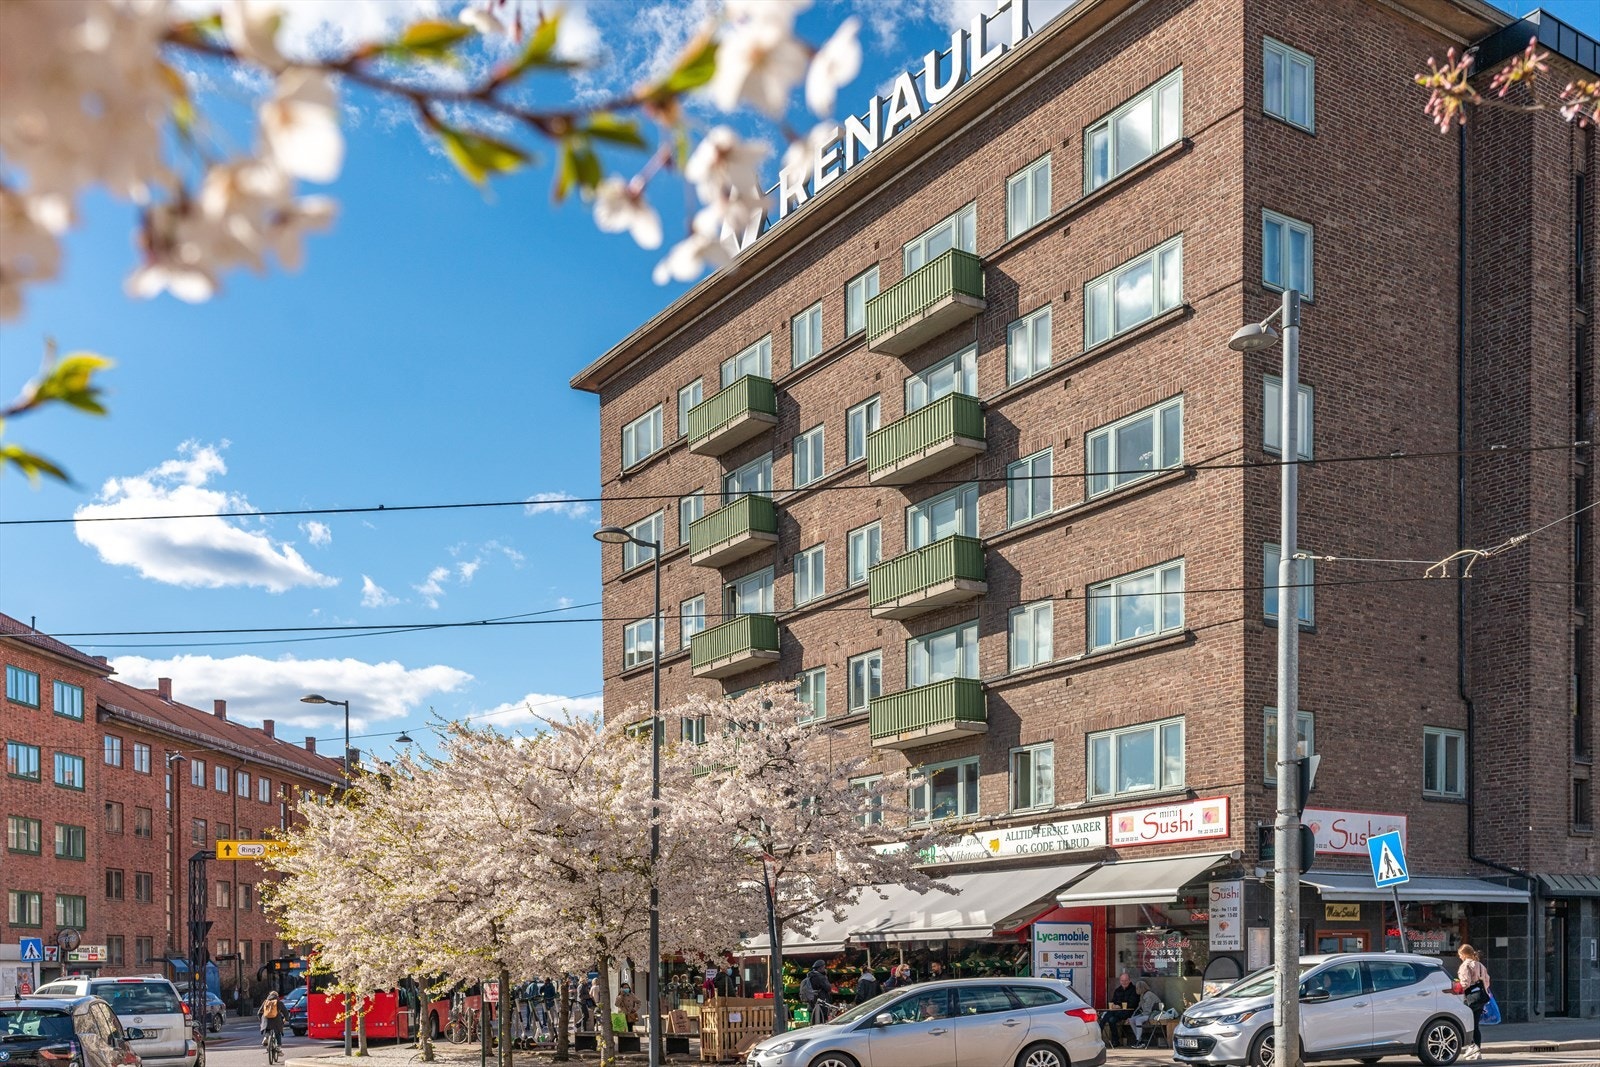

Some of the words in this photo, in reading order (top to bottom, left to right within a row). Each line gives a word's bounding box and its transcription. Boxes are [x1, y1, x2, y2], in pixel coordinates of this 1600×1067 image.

[779, 0, 1028, 219] RENAULT
[1159, 806, 1178, 819] mini
[1005, 829, 1034, 842] ALLTID
[1072, 820, 1101, 834] VARER
[1140, 808, 1194, 840] Sushi
[1329, 818, 1382, 850] Sush
[241, 846, 256, 854] Ring
[1015, 844, 1029, 855] OG
[1030, 841, 1054, 853] GODE
[1057, 837, 1090, 851] TILBUD
[1210, 885, 1239, 902] Sushi
[1036, 930, 1090, 943] Lycamobile
[1054, 952, 1073, 960] Selges
